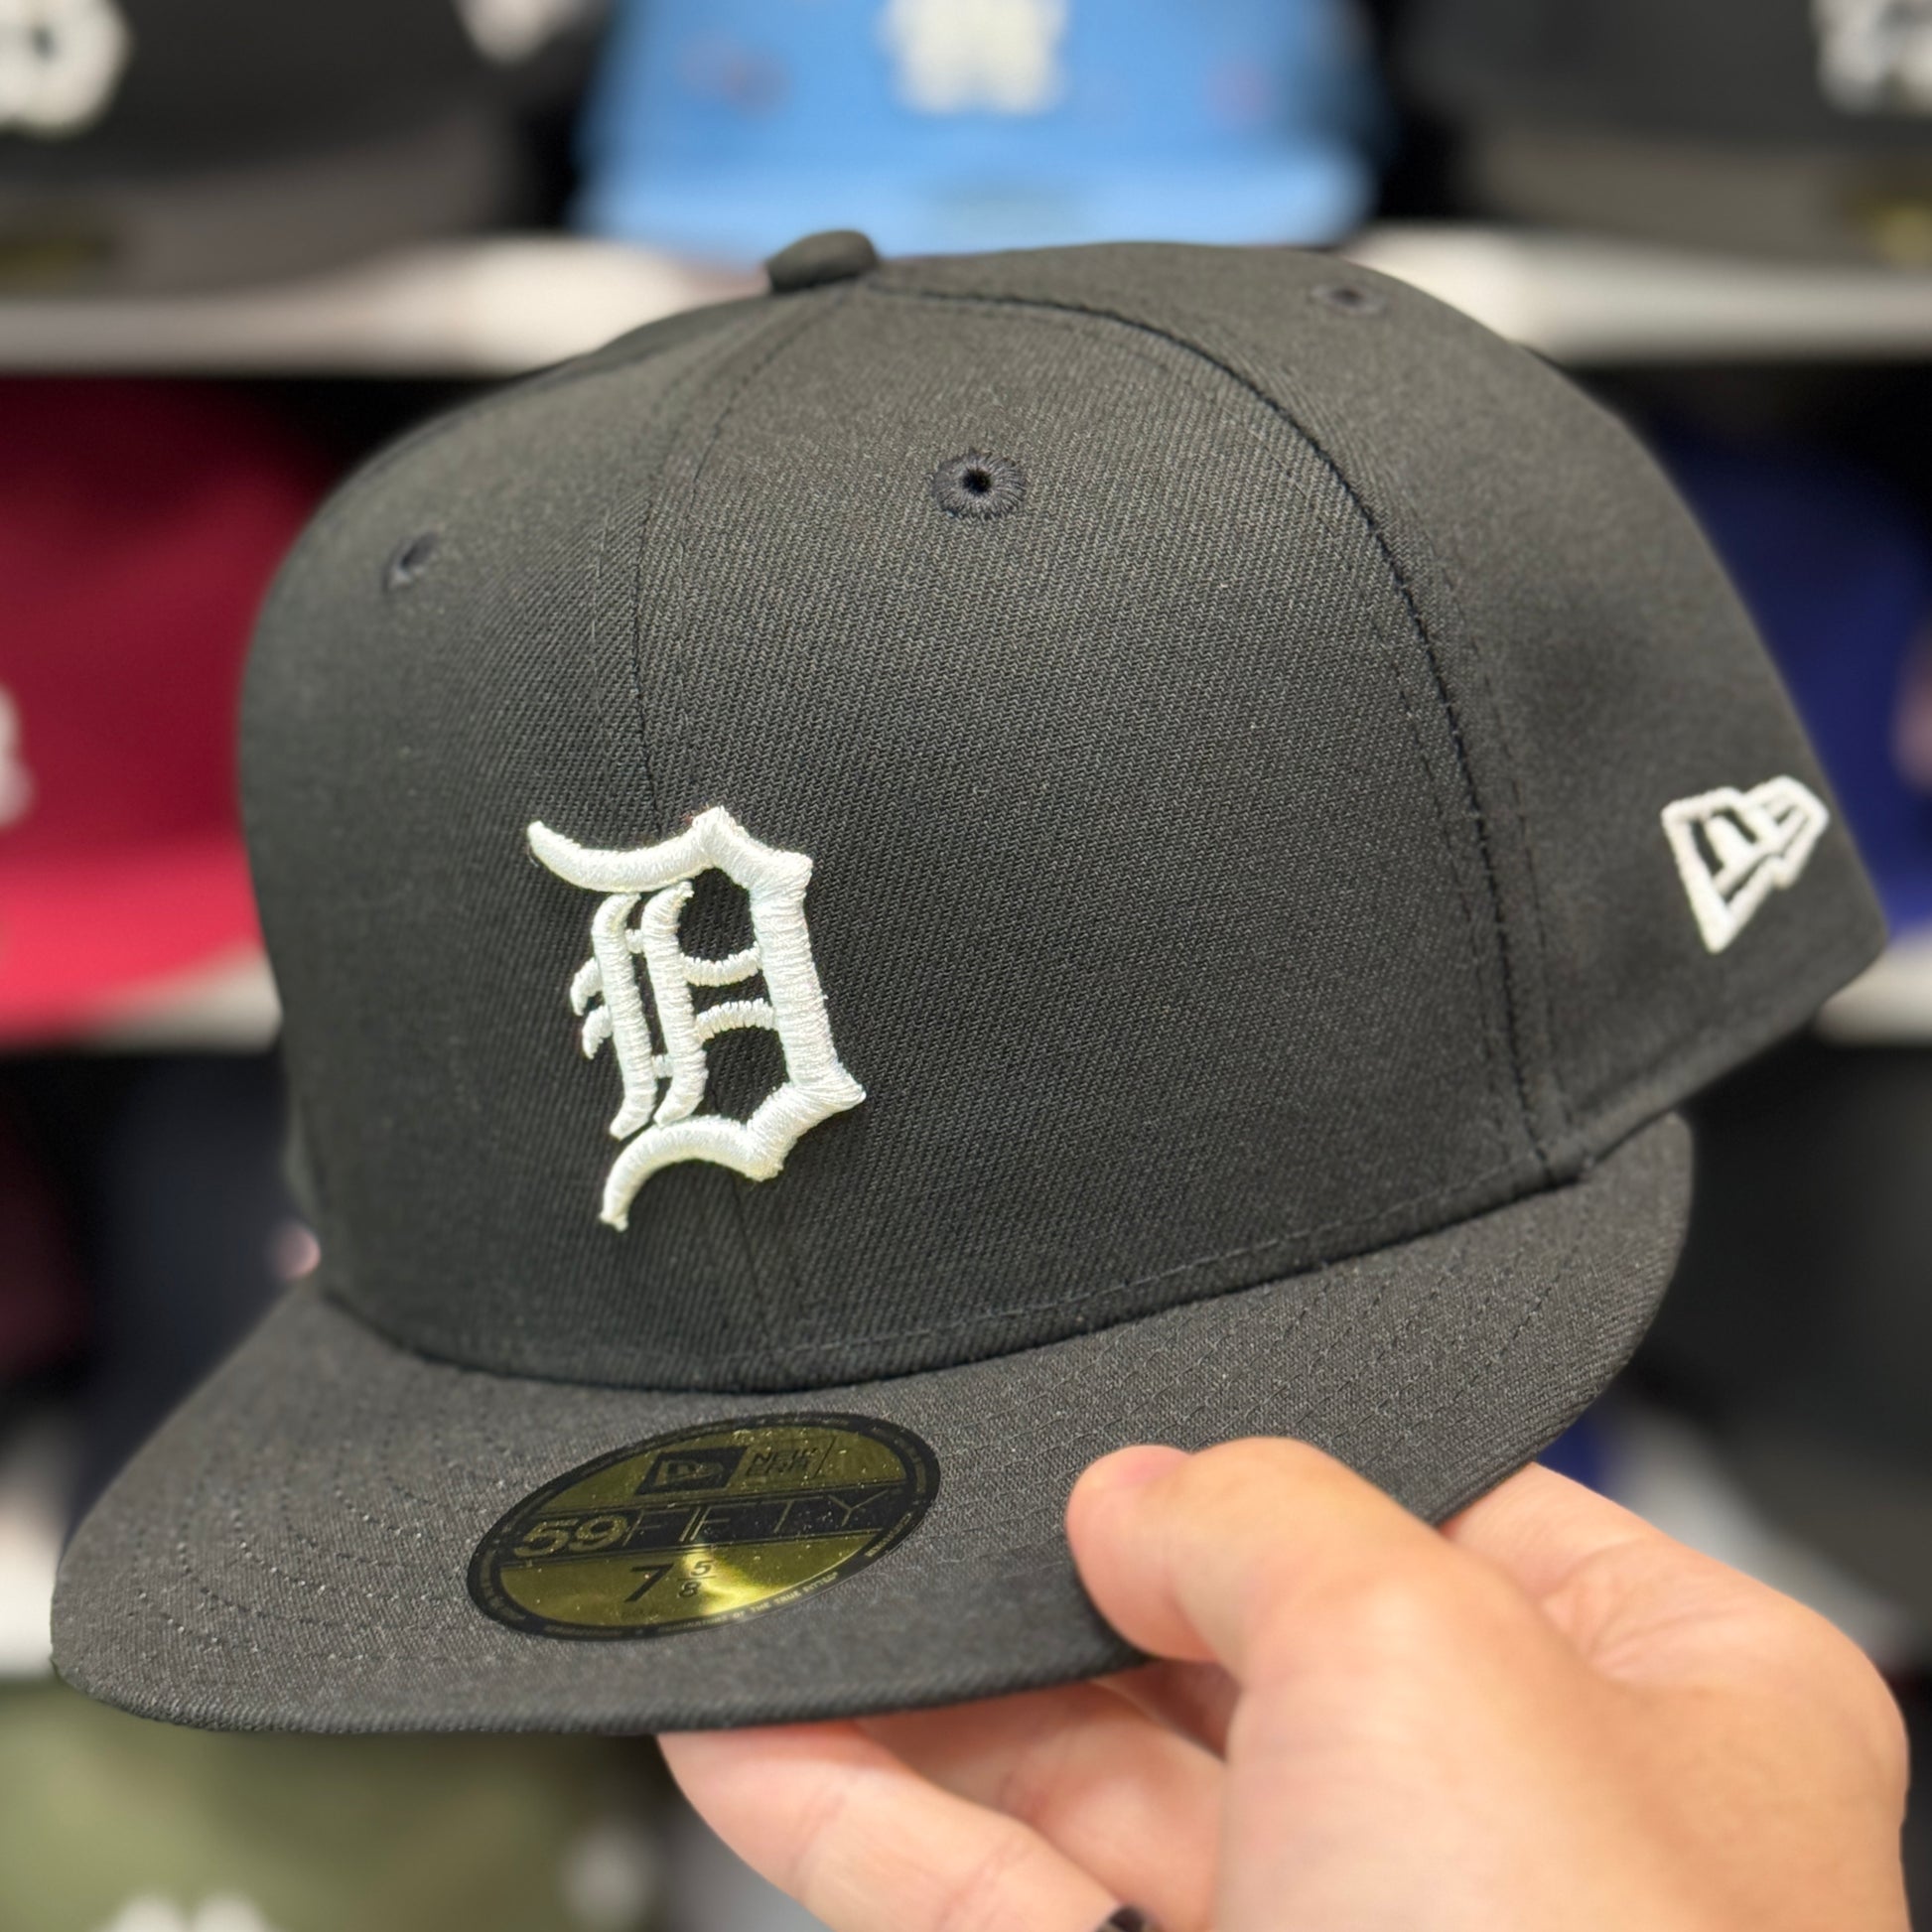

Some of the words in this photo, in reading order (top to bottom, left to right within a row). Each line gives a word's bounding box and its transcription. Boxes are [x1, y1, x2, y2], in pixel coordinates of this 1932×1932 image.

[527, 806, 866, 1231] D
[513, 1489, 890, 1559] 59FIFTY
[623, 1563, 675, 1603] 7
[773, 1590, 802, 1605] TRUE
